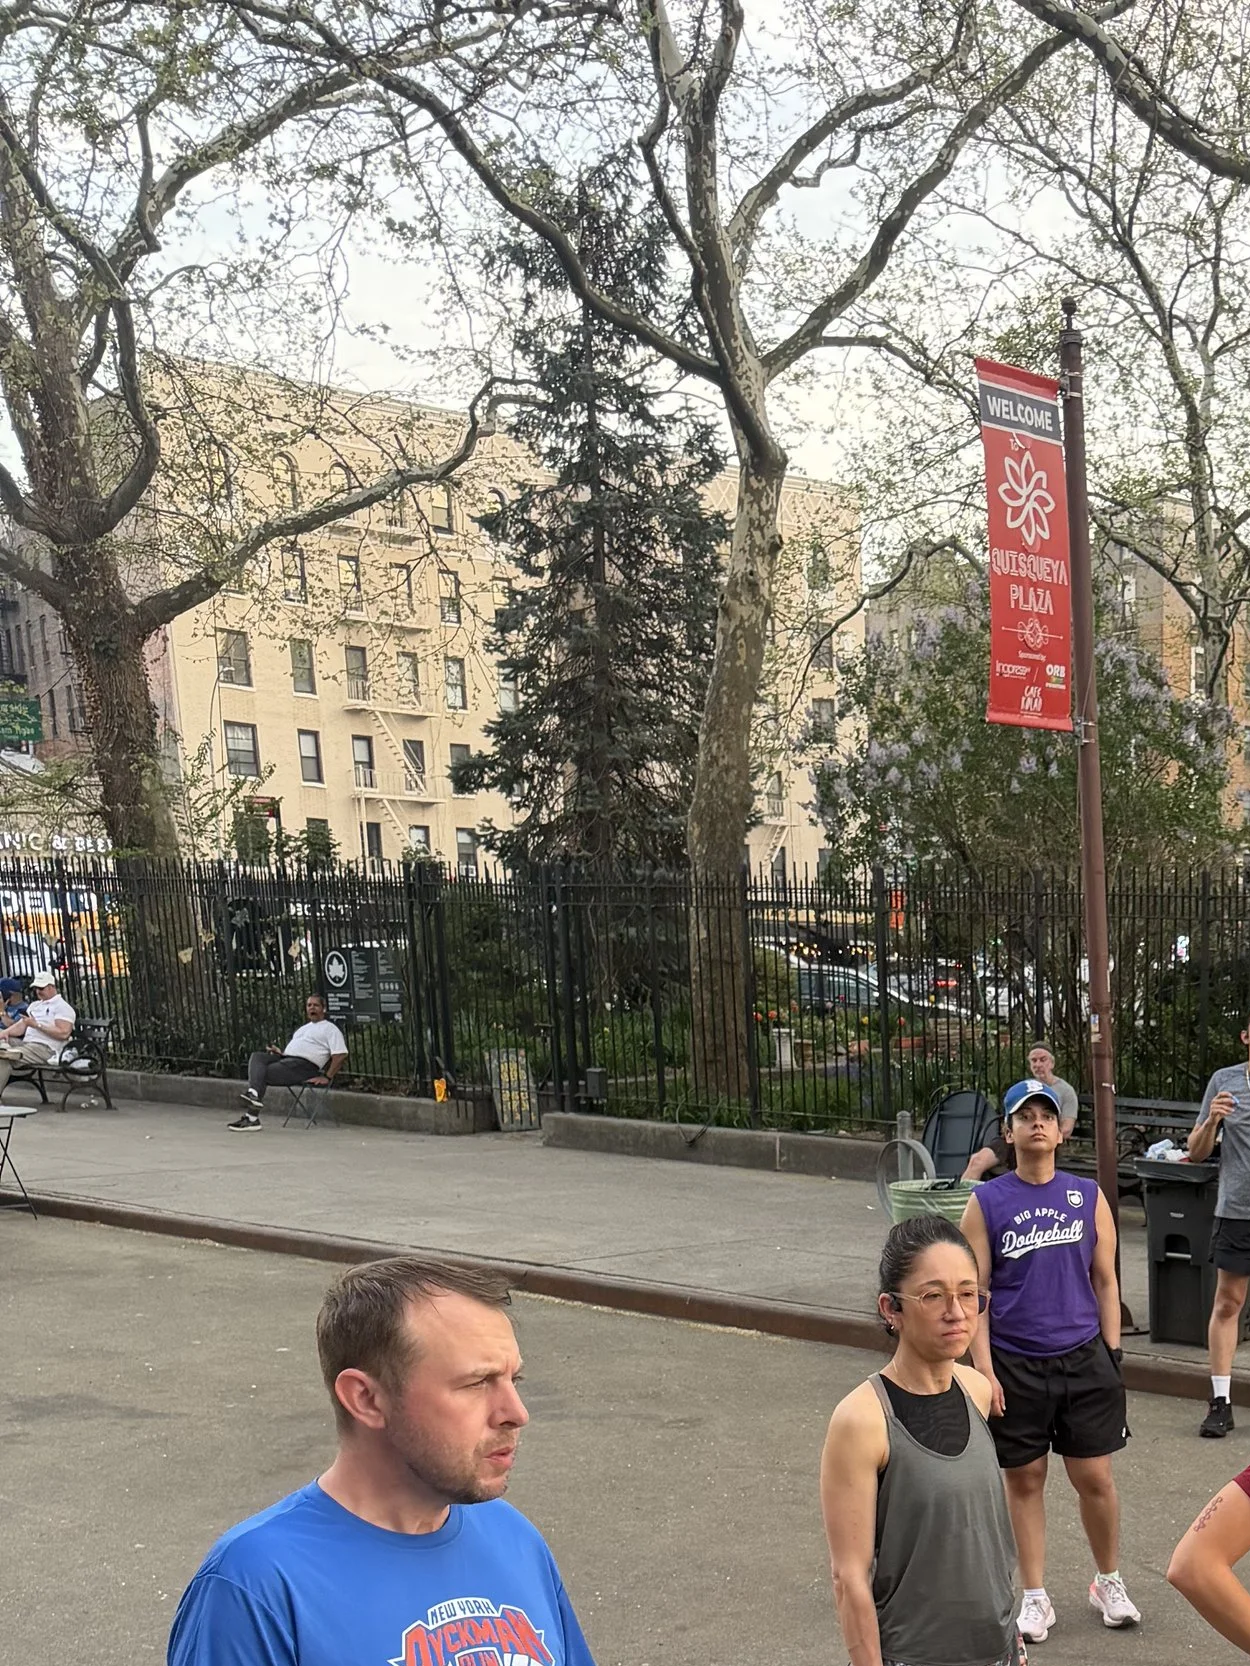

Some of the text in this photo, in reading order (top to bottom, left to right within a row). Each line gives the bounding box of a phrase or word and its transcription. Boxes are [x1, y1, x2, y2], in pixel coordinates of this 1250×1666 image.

[986, 394, 1053, 432] WELCOME
[991, 547, 1068, 586] QUISQUEYA
[1010, 583, 1054, 615] PLAZA
[1045, 663, 1066, 678] ORB
[0, 834, 42, 851] NIC
[1013, 1207, 1068, 1225] BIG APPLE
[1001, 1219, 1084, 1254] Dodgeball
[431, 1600, 495, 1626] NEW YORK
